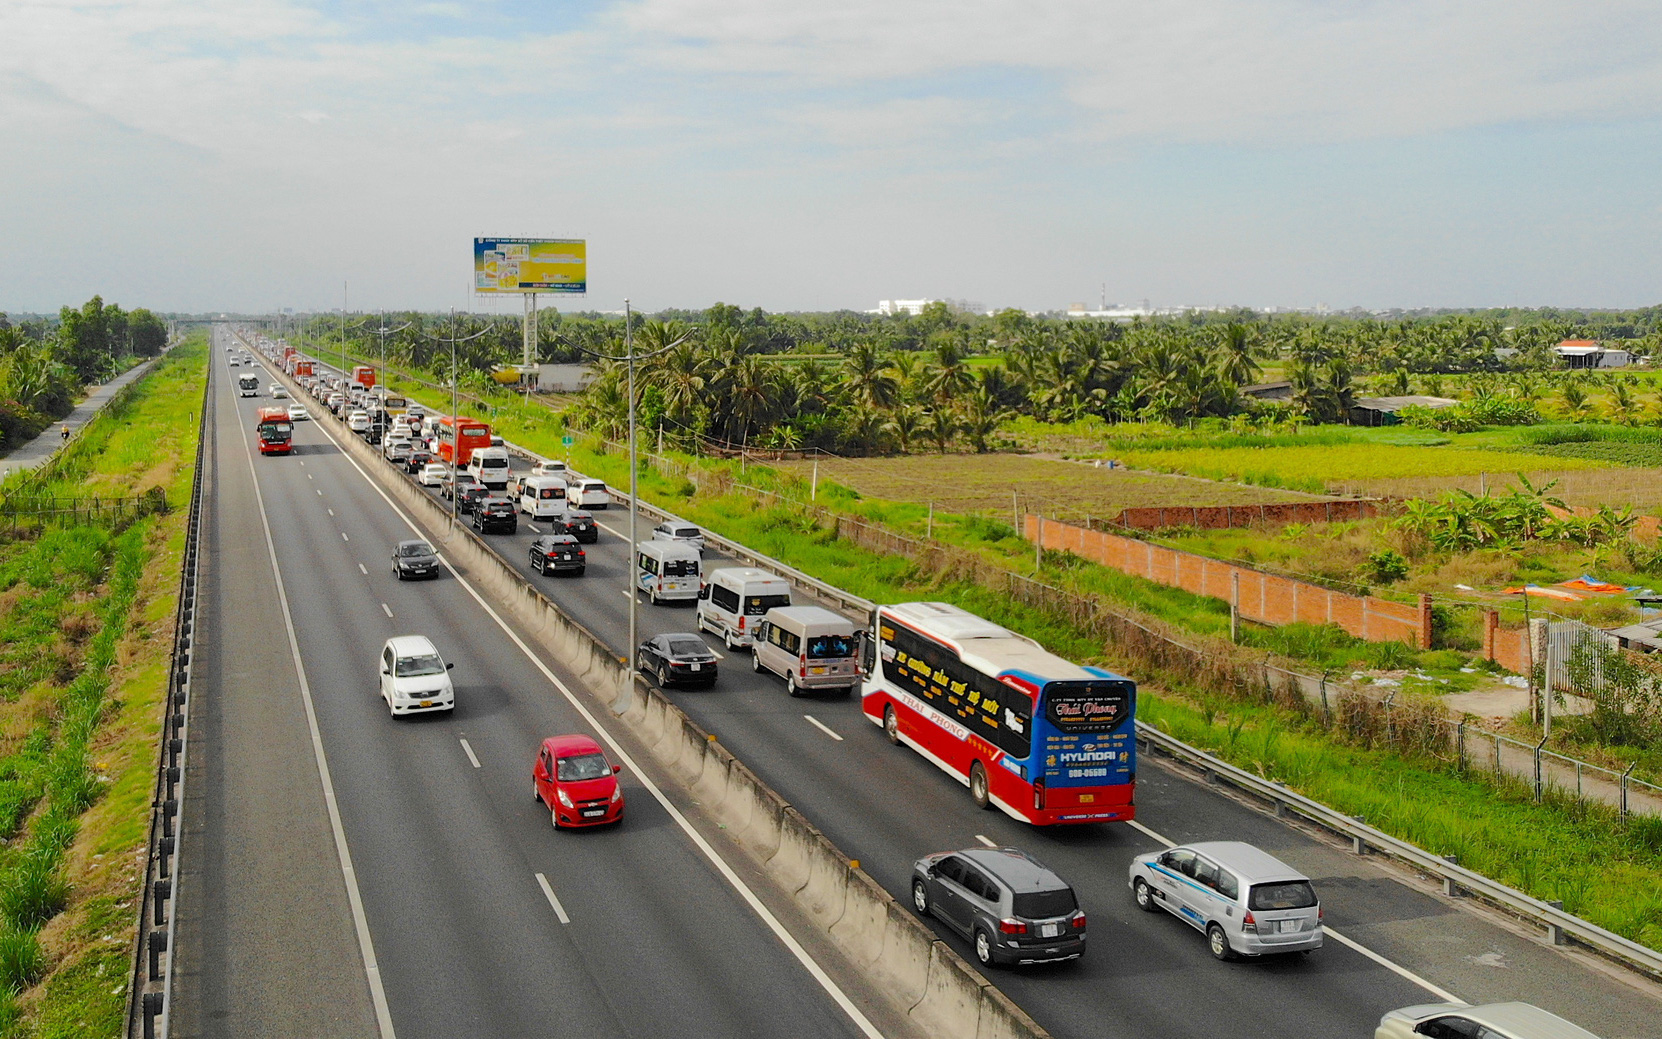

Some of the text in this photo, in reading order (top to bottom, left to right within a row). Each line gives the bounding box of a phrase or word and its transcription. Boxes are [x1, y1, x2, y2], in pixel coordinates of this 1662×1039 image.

[1056, 702, 1117, 716] Thái Phong
[930, 713, 966, 738] PHONG
[1060, 752, 1116, 762] HYUNDAI
